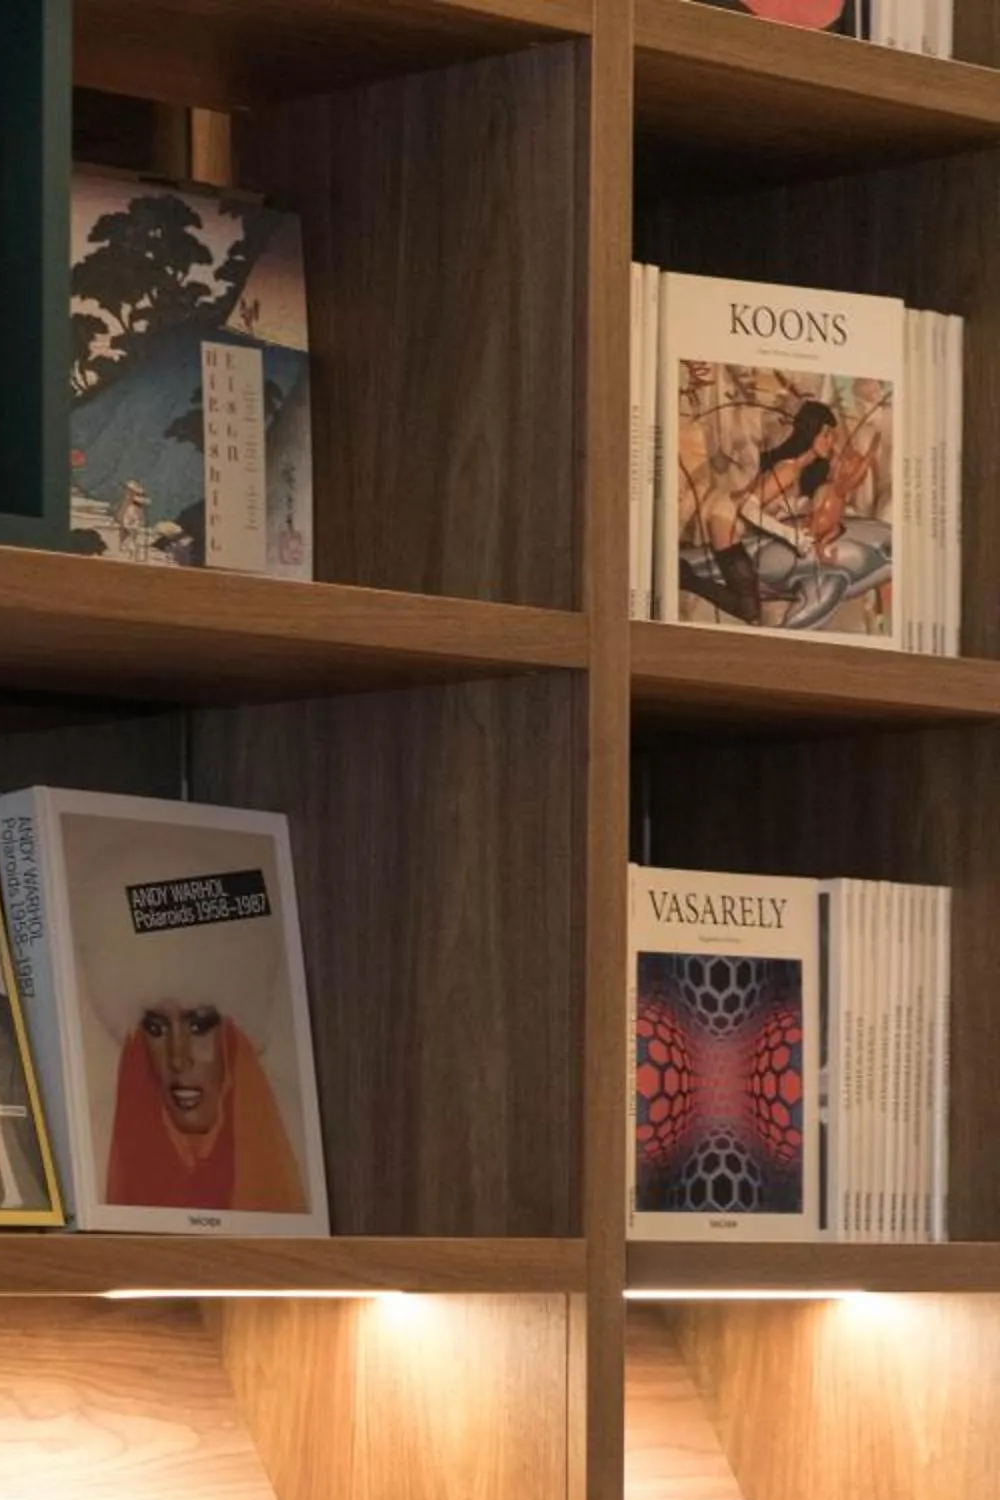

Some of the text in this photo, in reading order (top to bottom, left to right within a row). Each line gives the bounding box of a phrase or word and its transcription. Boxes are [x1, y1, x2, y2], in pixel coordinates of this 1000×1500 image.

[728, 303, 848, 346] KOONS
[131, 879, 231, 909] ANDY WARHOL
[648, 889, 788, 928] VASARELY
[133, 905, 196, 930] Polaroids
